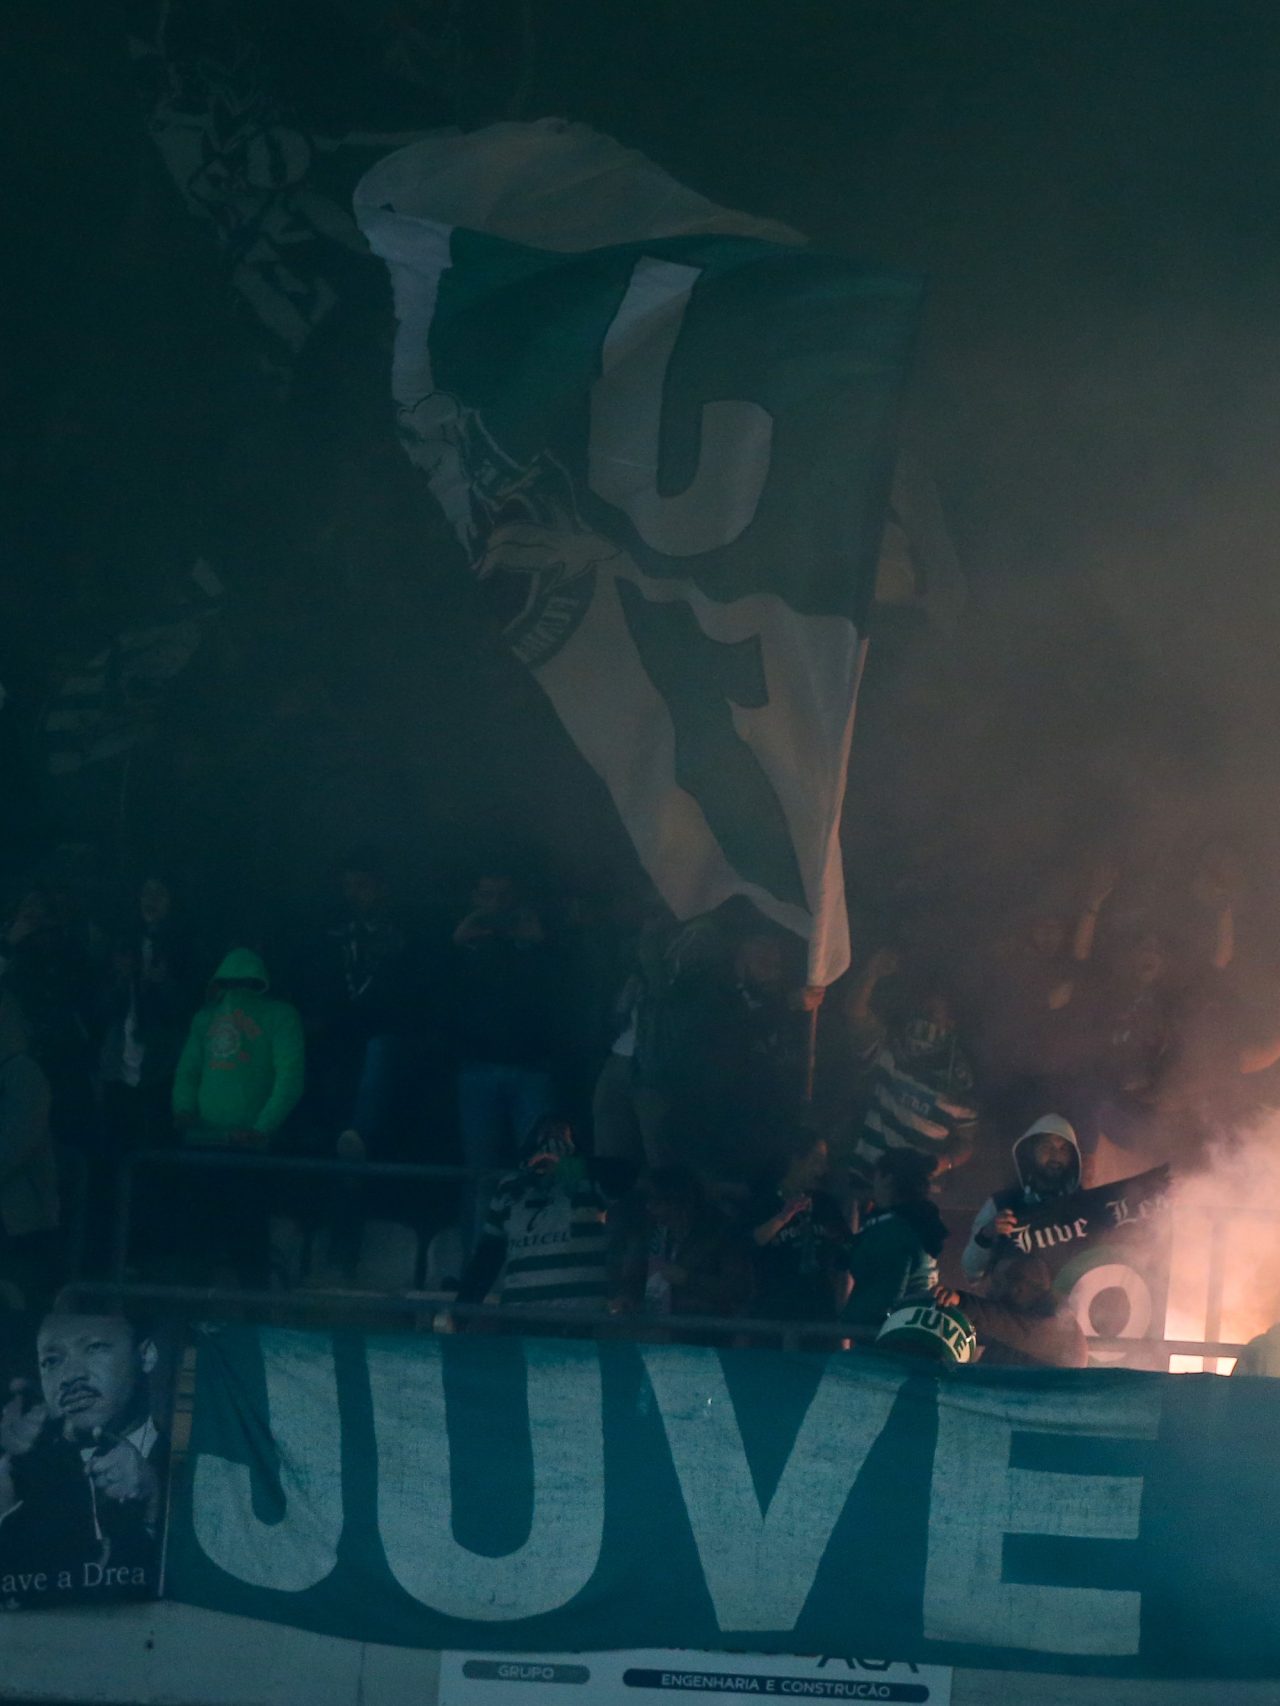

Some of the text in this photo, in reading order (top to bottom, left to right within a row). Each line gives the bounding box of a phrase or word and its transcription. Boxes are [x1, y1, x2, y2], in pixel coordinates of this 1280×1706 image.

[1012, 1217, 1088, 1254] Juve
[193, 1325, 1162, 1656] JUVE
[57, 1570, 73, 1590] a
[498, 1664, 554, 1680] GRUPO
[662, 1674, 760, 1692] ENGENHARIA
[766, 1679, 776, 1692] E
